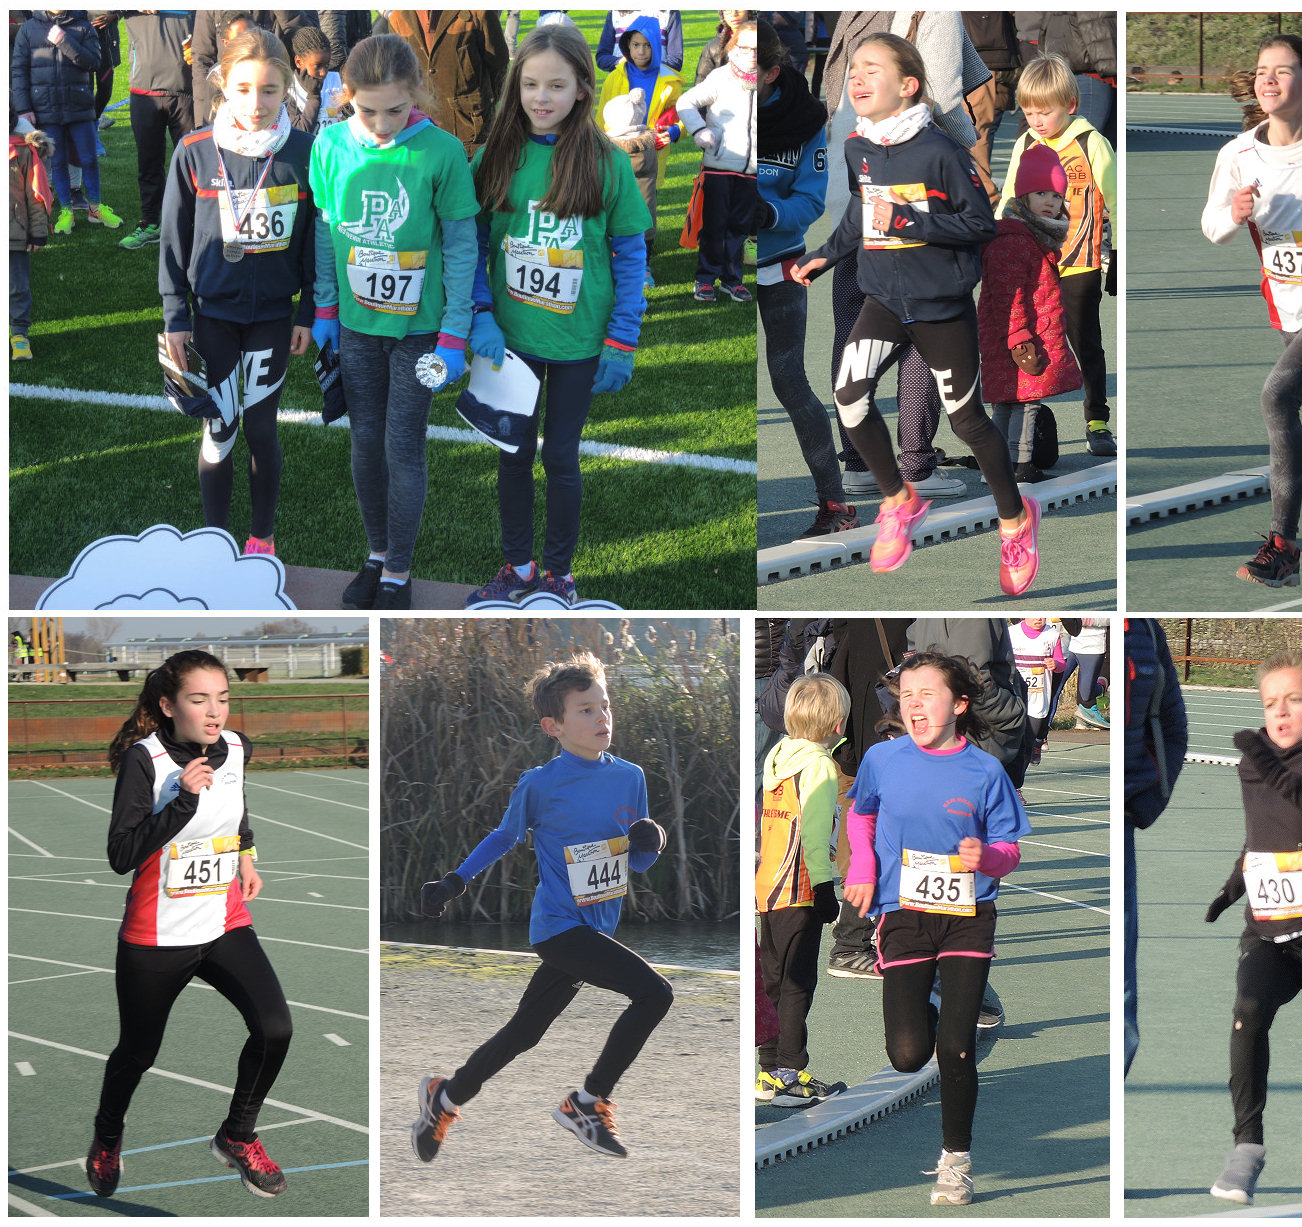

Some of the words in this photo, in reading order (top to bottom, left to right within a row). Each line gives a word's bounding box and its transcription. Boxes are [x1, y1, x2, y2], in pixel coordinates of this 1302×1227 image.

[239, 210, 285, 240] 436
[366, 272, 413, 301] 197
[516, 264, 561, 299] 194
[183, 857, 222, 884] 451
[587, 859, 622, 890] 444
[915, 874, 962, 902] 435
[1257, 878, 1296, 904] 430
